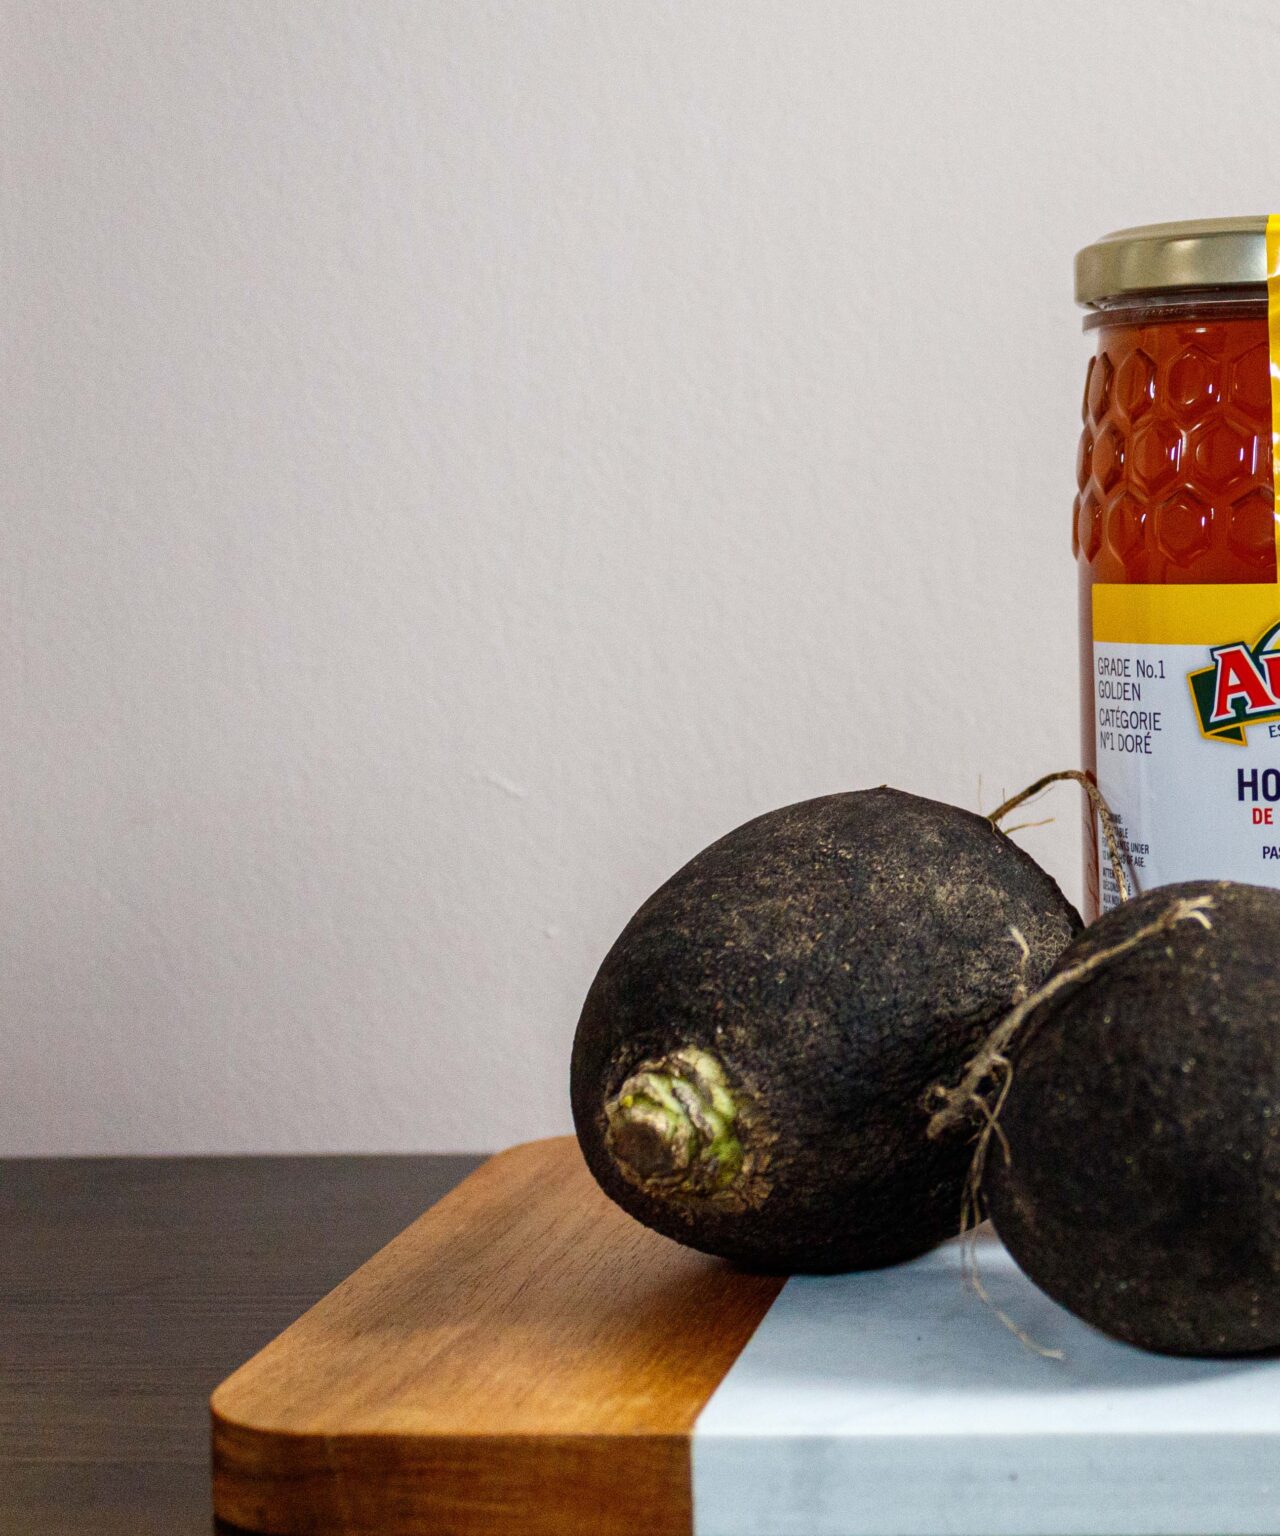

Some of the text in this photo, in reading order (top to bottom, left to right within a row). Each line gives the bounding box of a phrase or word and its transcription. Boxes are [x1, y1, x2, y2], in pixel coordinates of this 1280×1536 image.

[1098, 657, 1165, 679] GRADE No.1
[1098, 680, 1141, 701] GOLDEN
[1099, 707, 1162, 731] CATÉGORIE
[1118, 731, 1152, 754] DORÉ
[1252, 808, 1273, 825] DE
[1130, 843, 1150, 855] UNDER
